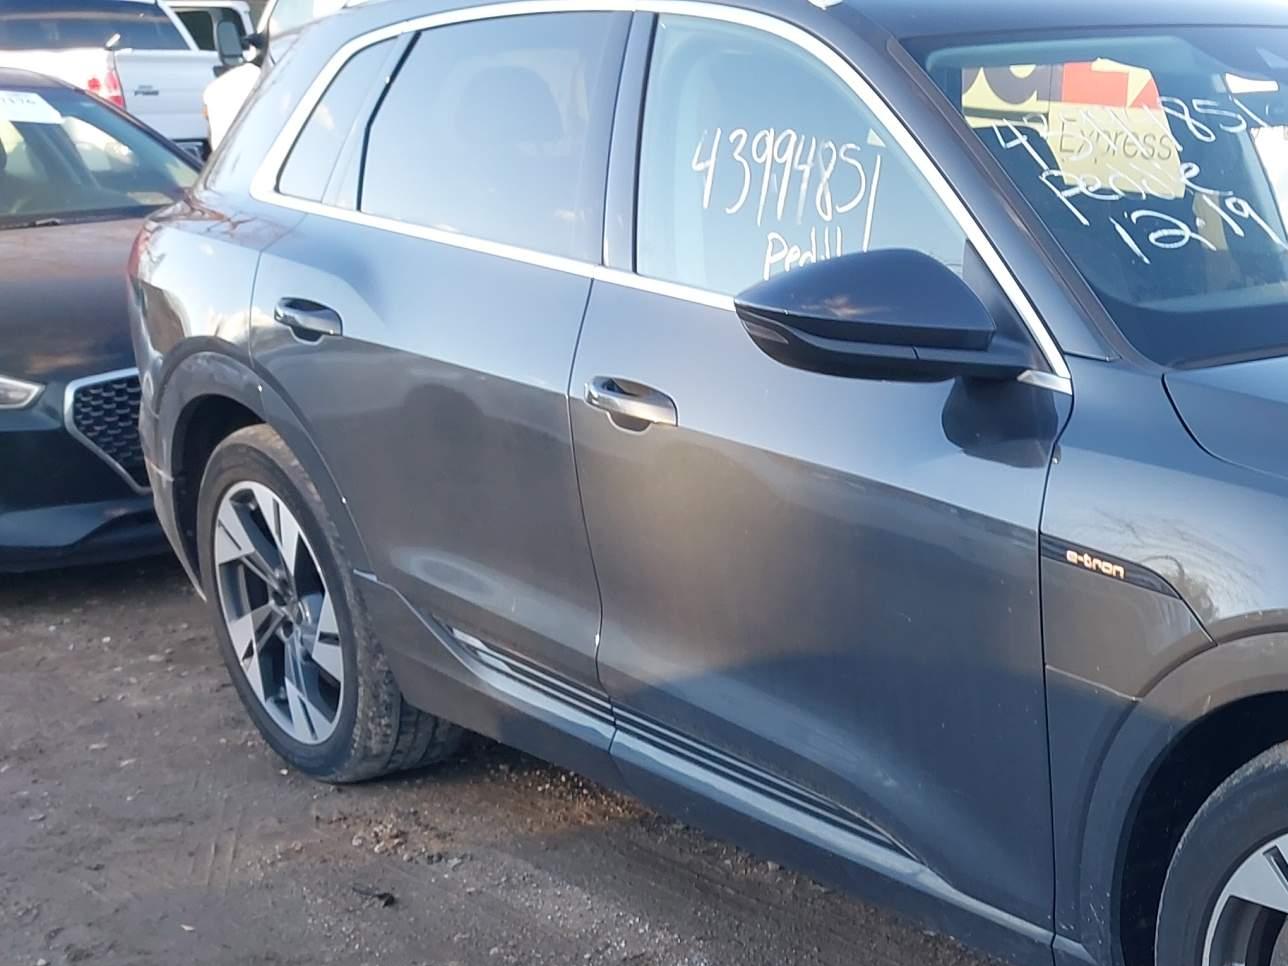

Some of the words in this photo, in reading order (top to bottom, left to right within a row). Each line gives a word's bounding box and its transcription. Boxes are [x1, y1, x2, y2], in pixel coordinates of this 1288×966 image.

[1059, 117, 1174, 164] Express
[691, 127, 881, 253] 43994851
[1065, 550, 1125, 579] e-tron
